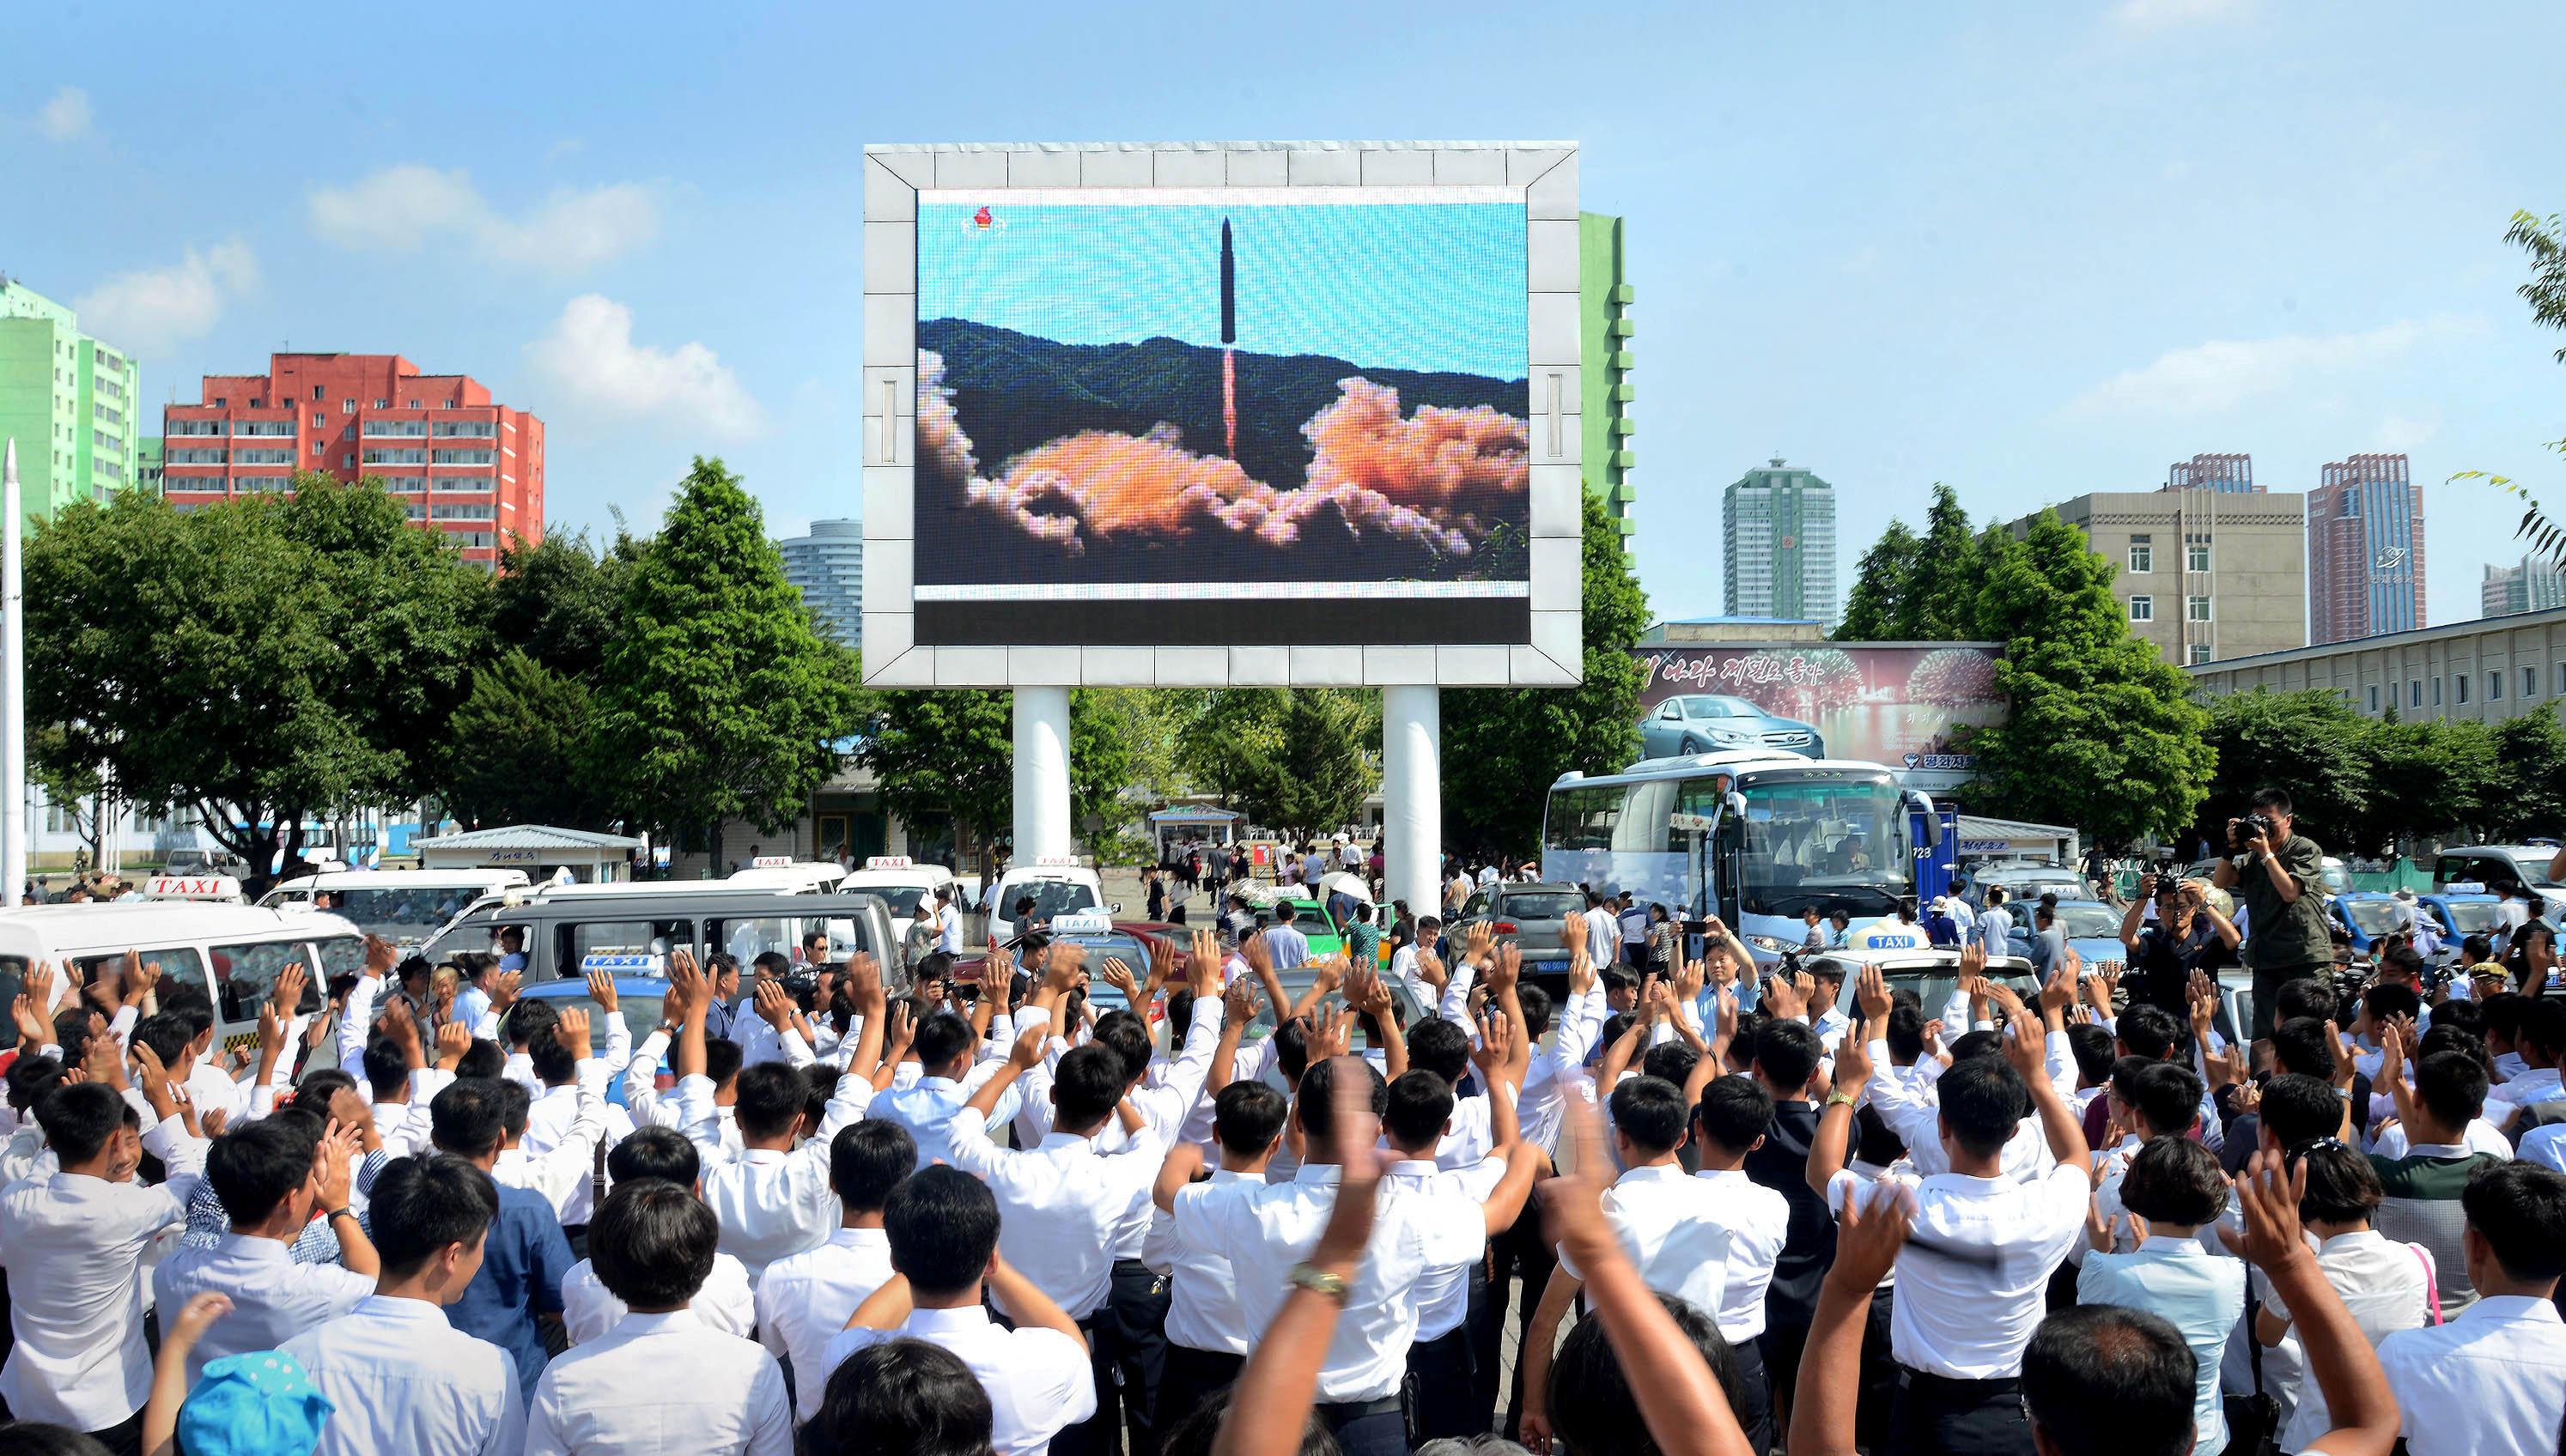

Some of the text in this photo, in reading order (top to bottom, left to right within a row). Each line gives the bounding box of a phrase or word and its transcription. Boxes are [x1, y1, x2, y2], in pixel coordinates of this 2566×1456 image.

[1662, 655, 1717, 687] 나라
[1912, 846, 1931, 858] 728
[155, 879, 220, 894] TAXI
[1876, 936, 1909, 948] TAXI
[588, 957, 646, 966] TAXI
